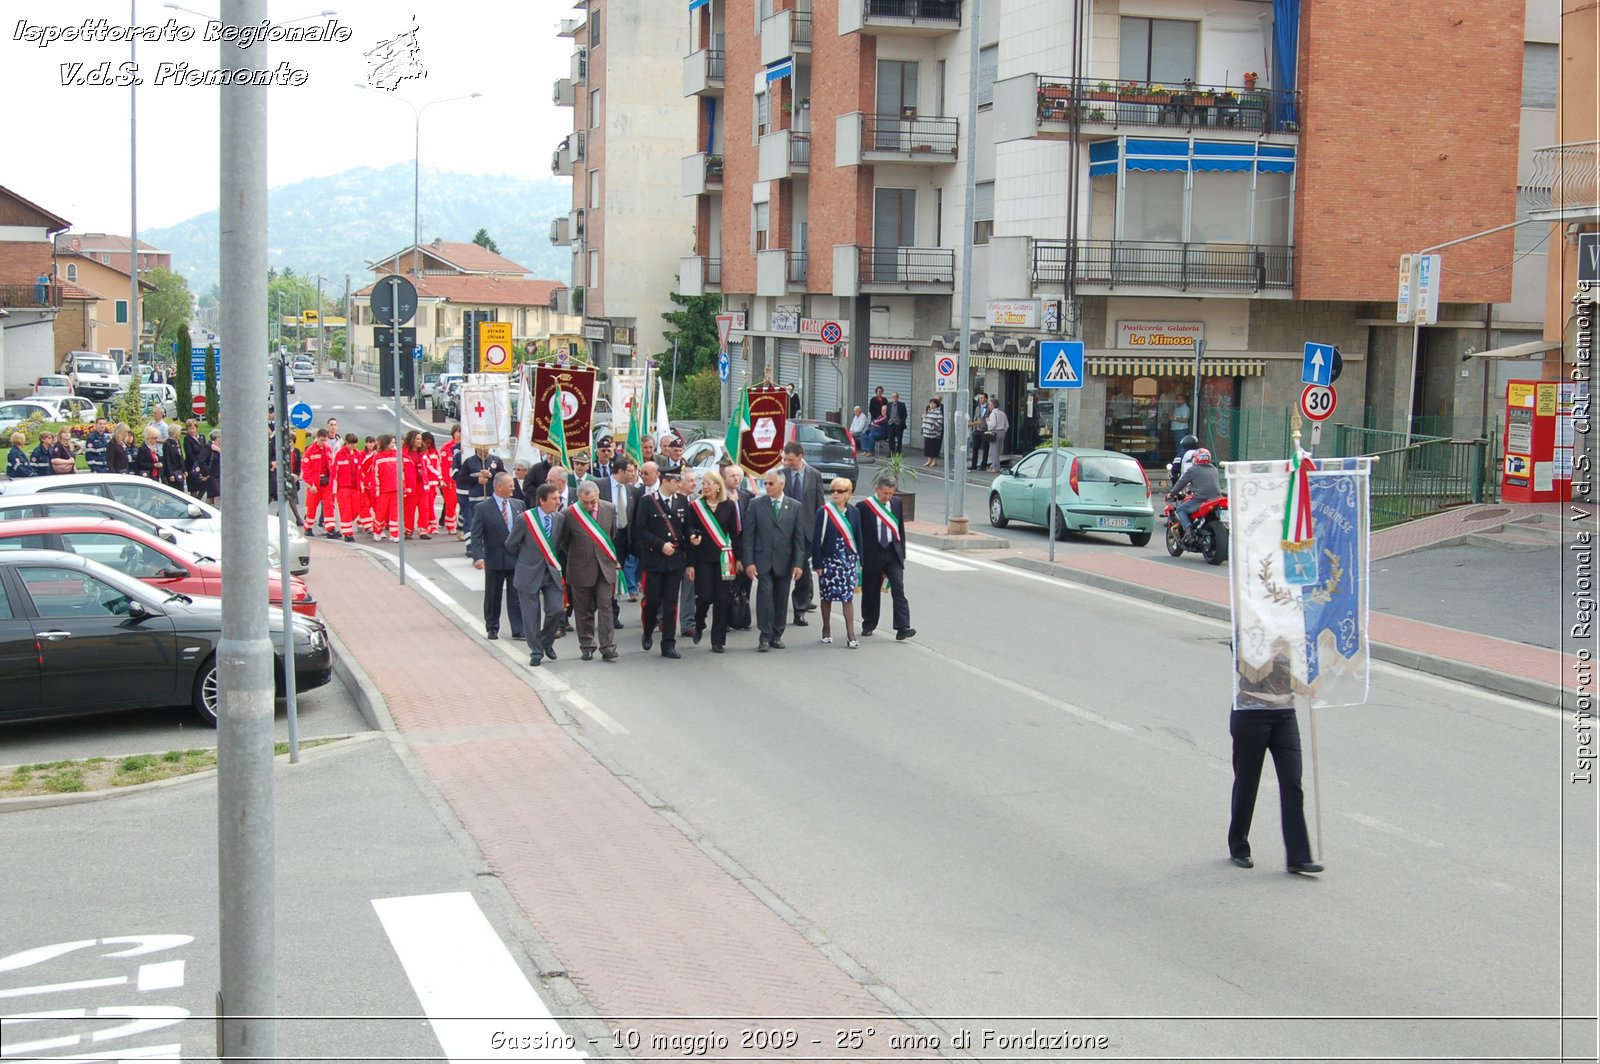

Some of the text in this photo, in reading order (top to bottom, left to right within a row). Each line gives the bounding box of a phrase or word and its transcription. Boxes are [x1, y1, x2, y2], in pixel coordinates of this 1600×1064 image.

[1129, 333, 1193, 346] La Mimosa
[1309, 392, 1330, 411] 30
[1243, 508, 1270, 537] COMUNE
[1318, 503, 1353, 534] TORINESE
